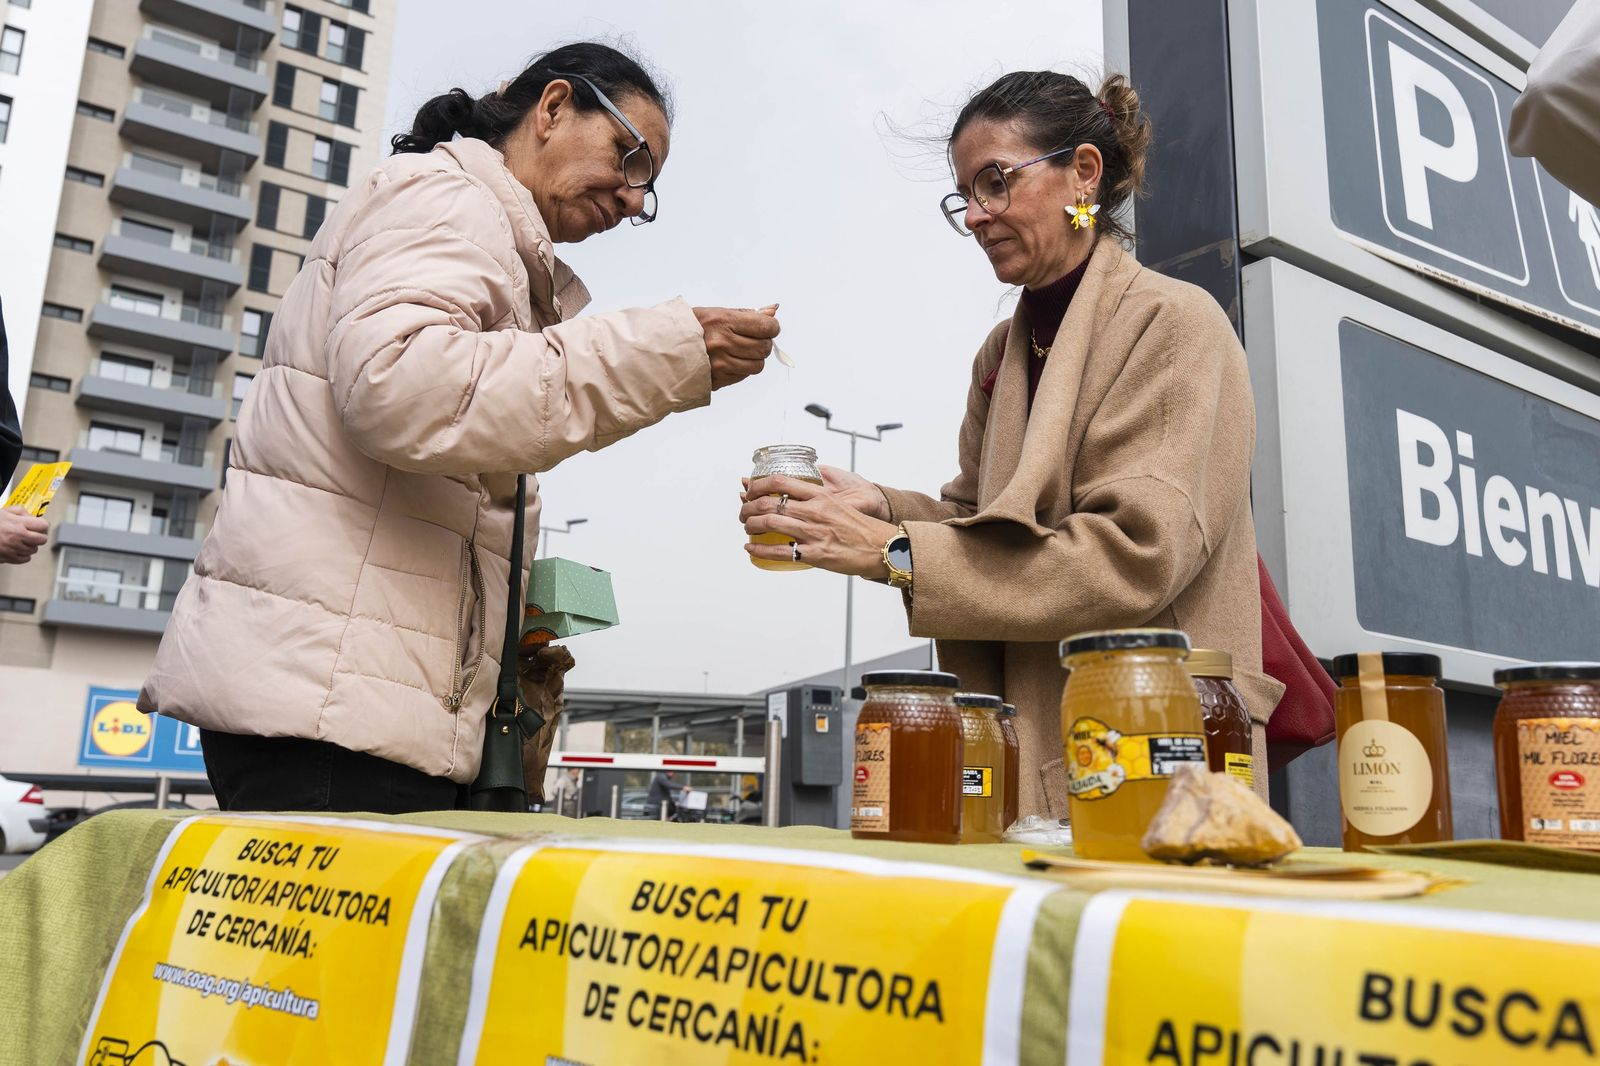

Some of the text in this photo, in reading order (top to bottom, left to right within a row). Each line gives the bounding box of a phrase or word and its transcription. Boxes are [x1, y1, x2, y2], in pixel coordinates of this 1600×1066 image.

[1388, 40, 1479, 231] P
[1396, 408, 1600, 588] Bienv
[1353, 759, 1401, 775] LIMÓN
[1524, 751, 1600, 765] MIL FLORE
[1545, 731, 1582, 745] MIEL
[237, 838, 341, 871] BUSCA TU
[162, 866, 392, 927] APICULTOR/APICULTORA
[631, 879, 809, 934] BUSCA TU
[186, 909, 318, 959] DE CERCANÍA:
[153, 961, 320, 1020] www.coag.org/apicultura
[519, 917, 946, 1024] APICULTOR/APICULTORA
[582, 981, 821, 1064] DE CERCANÍA:
[1358, 971, 1596, 1057] BUSCA
